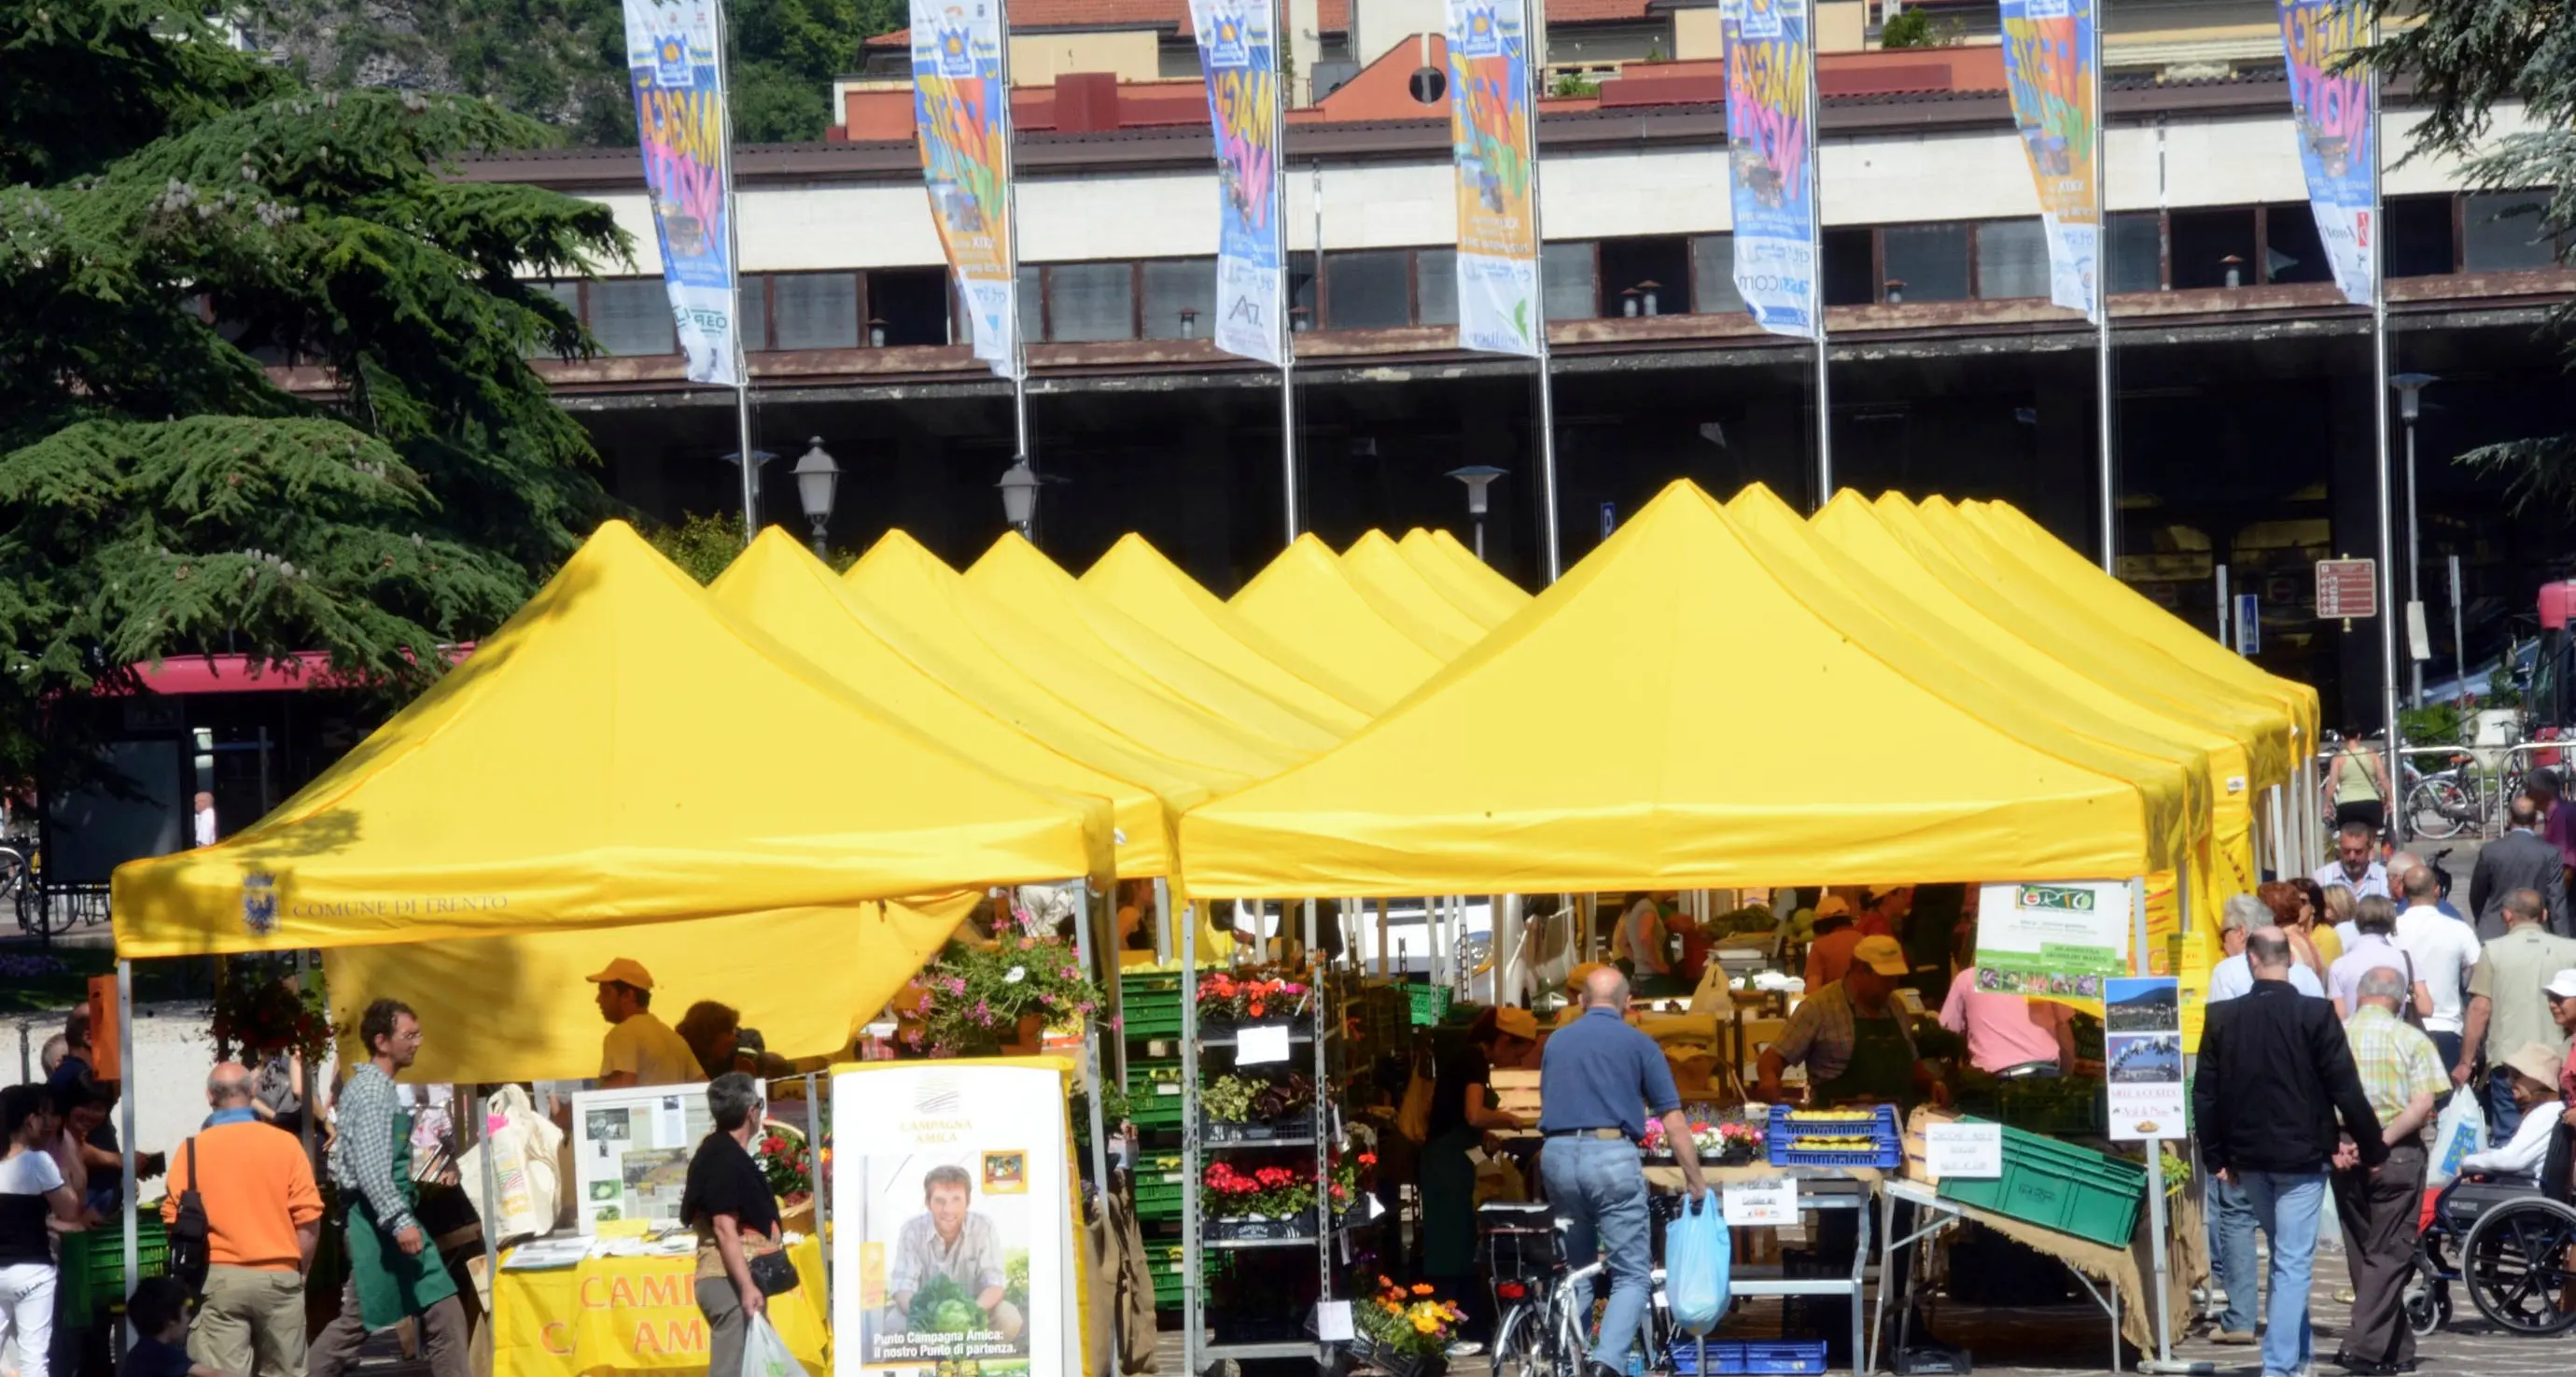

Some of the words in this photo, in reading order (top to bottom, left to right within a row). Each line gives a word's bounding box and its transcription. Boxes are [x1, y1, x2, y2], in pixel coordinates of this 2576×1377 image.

[1604, 509, 1613, 538] P
[293, 901, 387, 919] COMUNE
[395, 899, 417, 917] DI
[421, 895, 509, 915] TRENTO
[900, 1119, 973, 1131] CAMPAGNA
[916, 1132, 958, 1144] AMICA
[874, 1333, 904, 1346] Punto
[906, 1331, 964, 1345] Campagna
[966, 1329, 1004, 1342] Amica:
[883, 1345, 918, 1358] nostro
[920, 1344, 952, 1356] Punto
[953, 1342, 964, 1355] di
[966, 1342, 1017, 1356] partenza.
